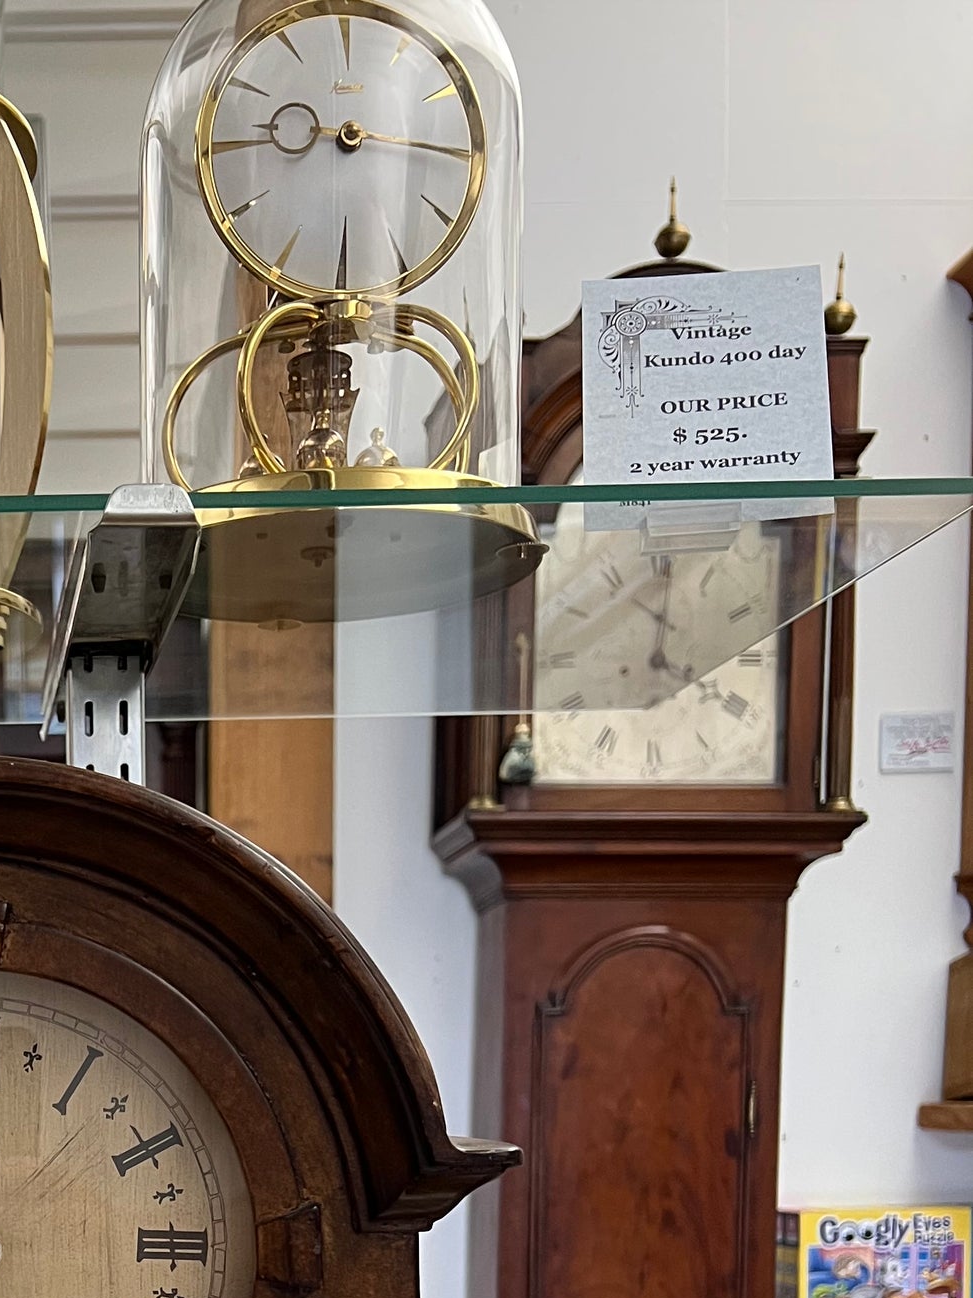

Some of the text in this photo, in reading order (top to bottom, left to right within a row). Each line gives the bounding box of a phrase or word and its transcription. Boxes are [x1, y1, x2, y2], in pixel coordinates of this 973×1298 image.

[670, 325, 752, 340] Vintage
[644, 345, 807, 368] Kundo 400 day
[660, 392, 788, 415] OUR PRICE
[672, 426, 748, 446] $ 525.
[630, 450, 802, 476] 2 year warranty
